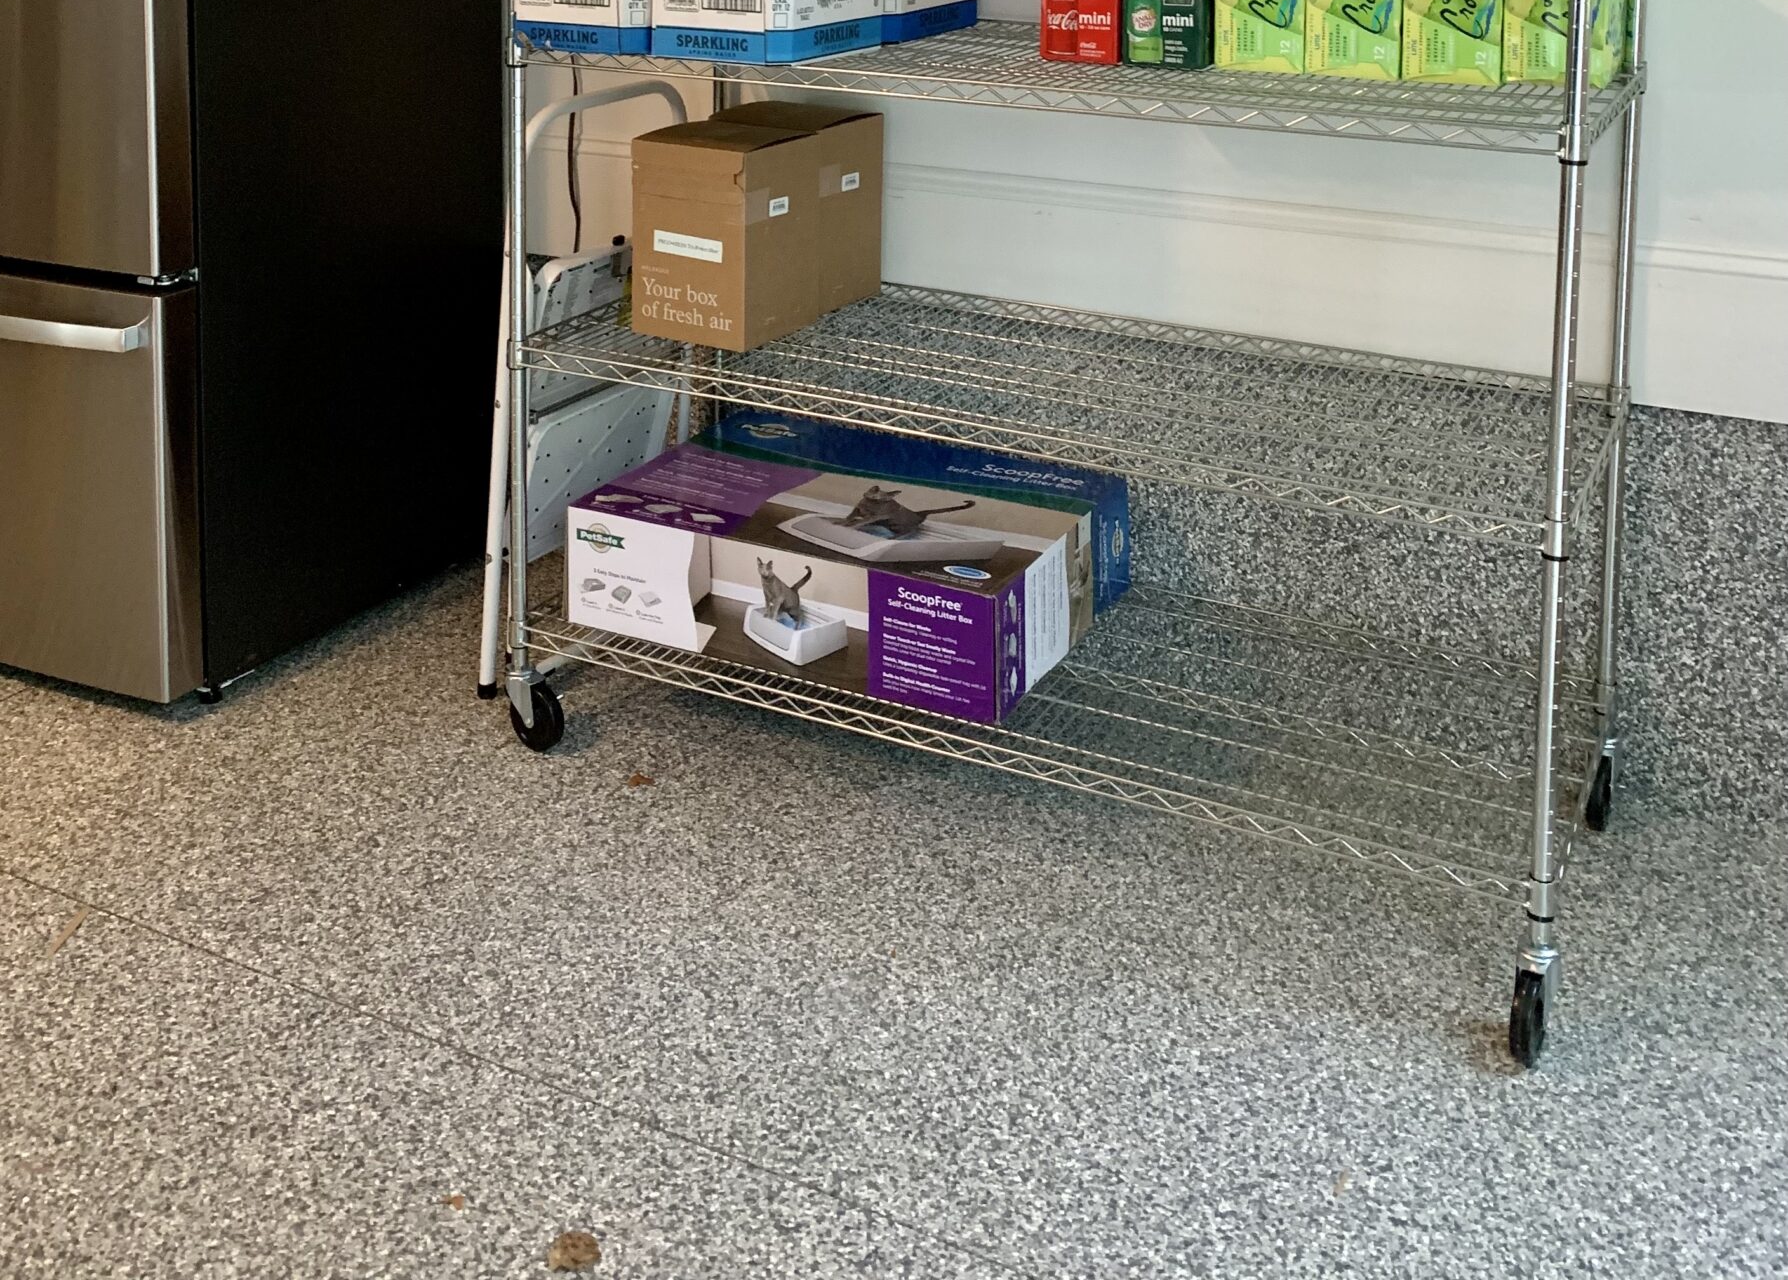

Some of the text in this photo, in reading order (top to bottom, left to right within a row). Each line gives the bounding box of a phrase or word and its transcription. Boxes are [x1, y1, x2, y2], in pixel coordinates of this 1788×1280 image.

[1079, 11, 1111, 25] mini
[1163, 13, 1194, 27] mini
[530, 27, 598, 45] SPARKLING
[676, 34, 748, 52] SPARKLING
[814, 24, 861, 46] SPARKLING
[1280, 39, 1291, 54] 12
[1374, 46, 1385, 61] 12
[1475, 51, 1487, 67] 12
[641, 277, 718, 307] Your box
[641, 301, 733, 331] of fresh air
[945, 464, 1077, 491] Self-Cleaning Litter Box
[981, 463, 1085, 486] ScoopFree
[579, 529, 618, 546] PetSafe
[897, 586, 962, 612] ScoopFree
[887, 598, 973, 625] Self-Cleaning Litter Box
